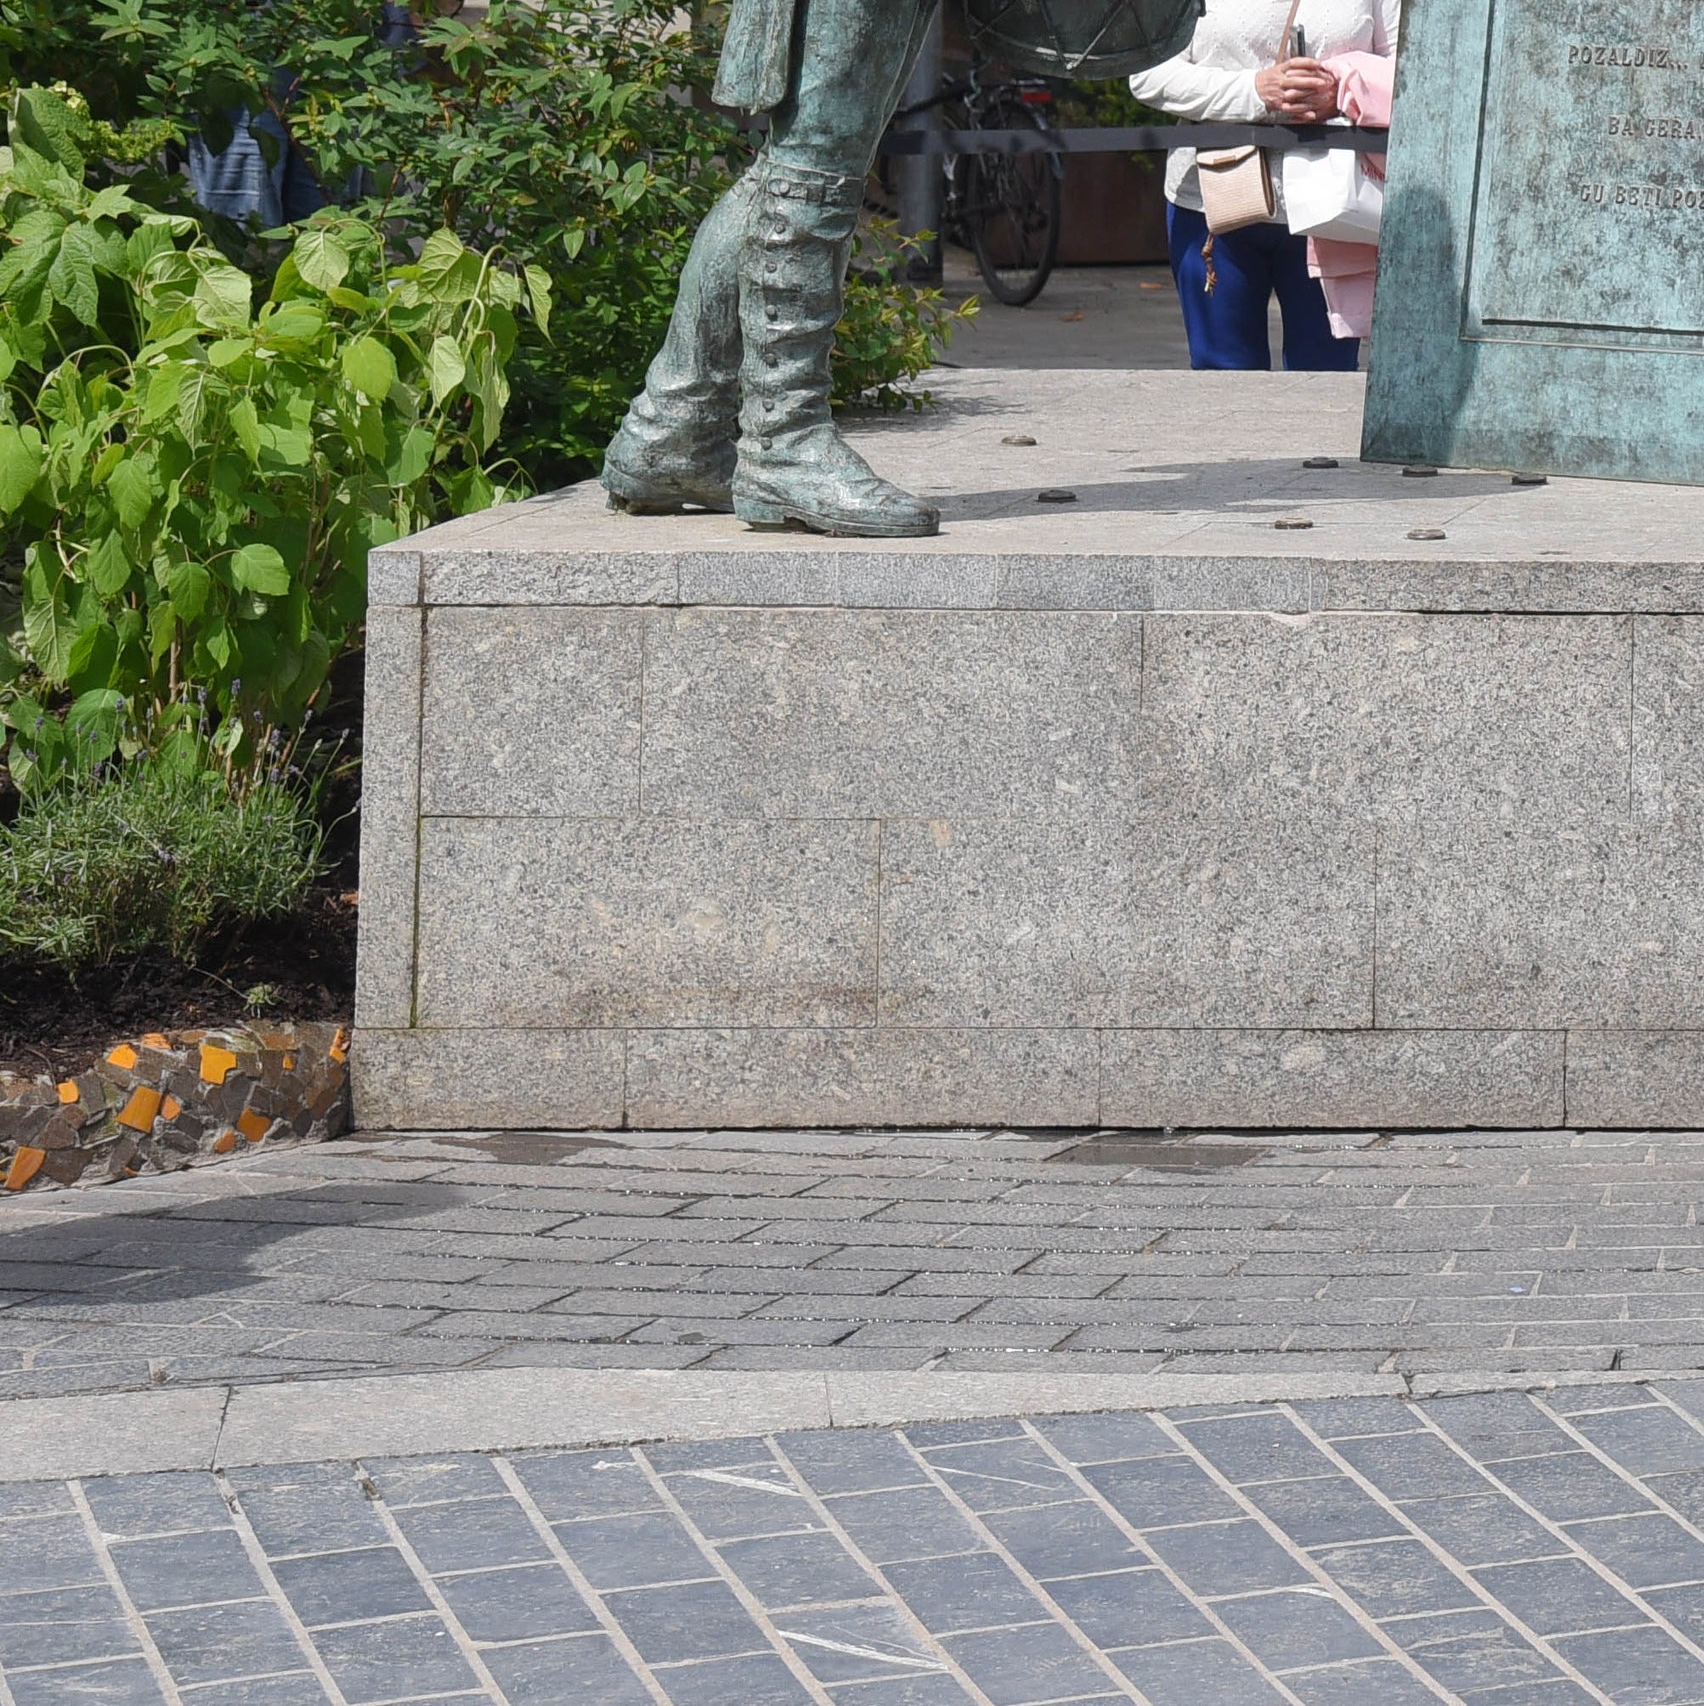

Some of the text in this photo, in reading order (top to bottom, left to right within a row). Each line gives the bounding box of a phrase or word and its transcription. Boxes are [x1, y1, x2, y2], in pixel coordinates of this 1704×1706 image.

[1608, 116, 1634, 136] BA
[1580, 184, 1604, 203] GU
[1615, 185, 1662, 206] BETI
